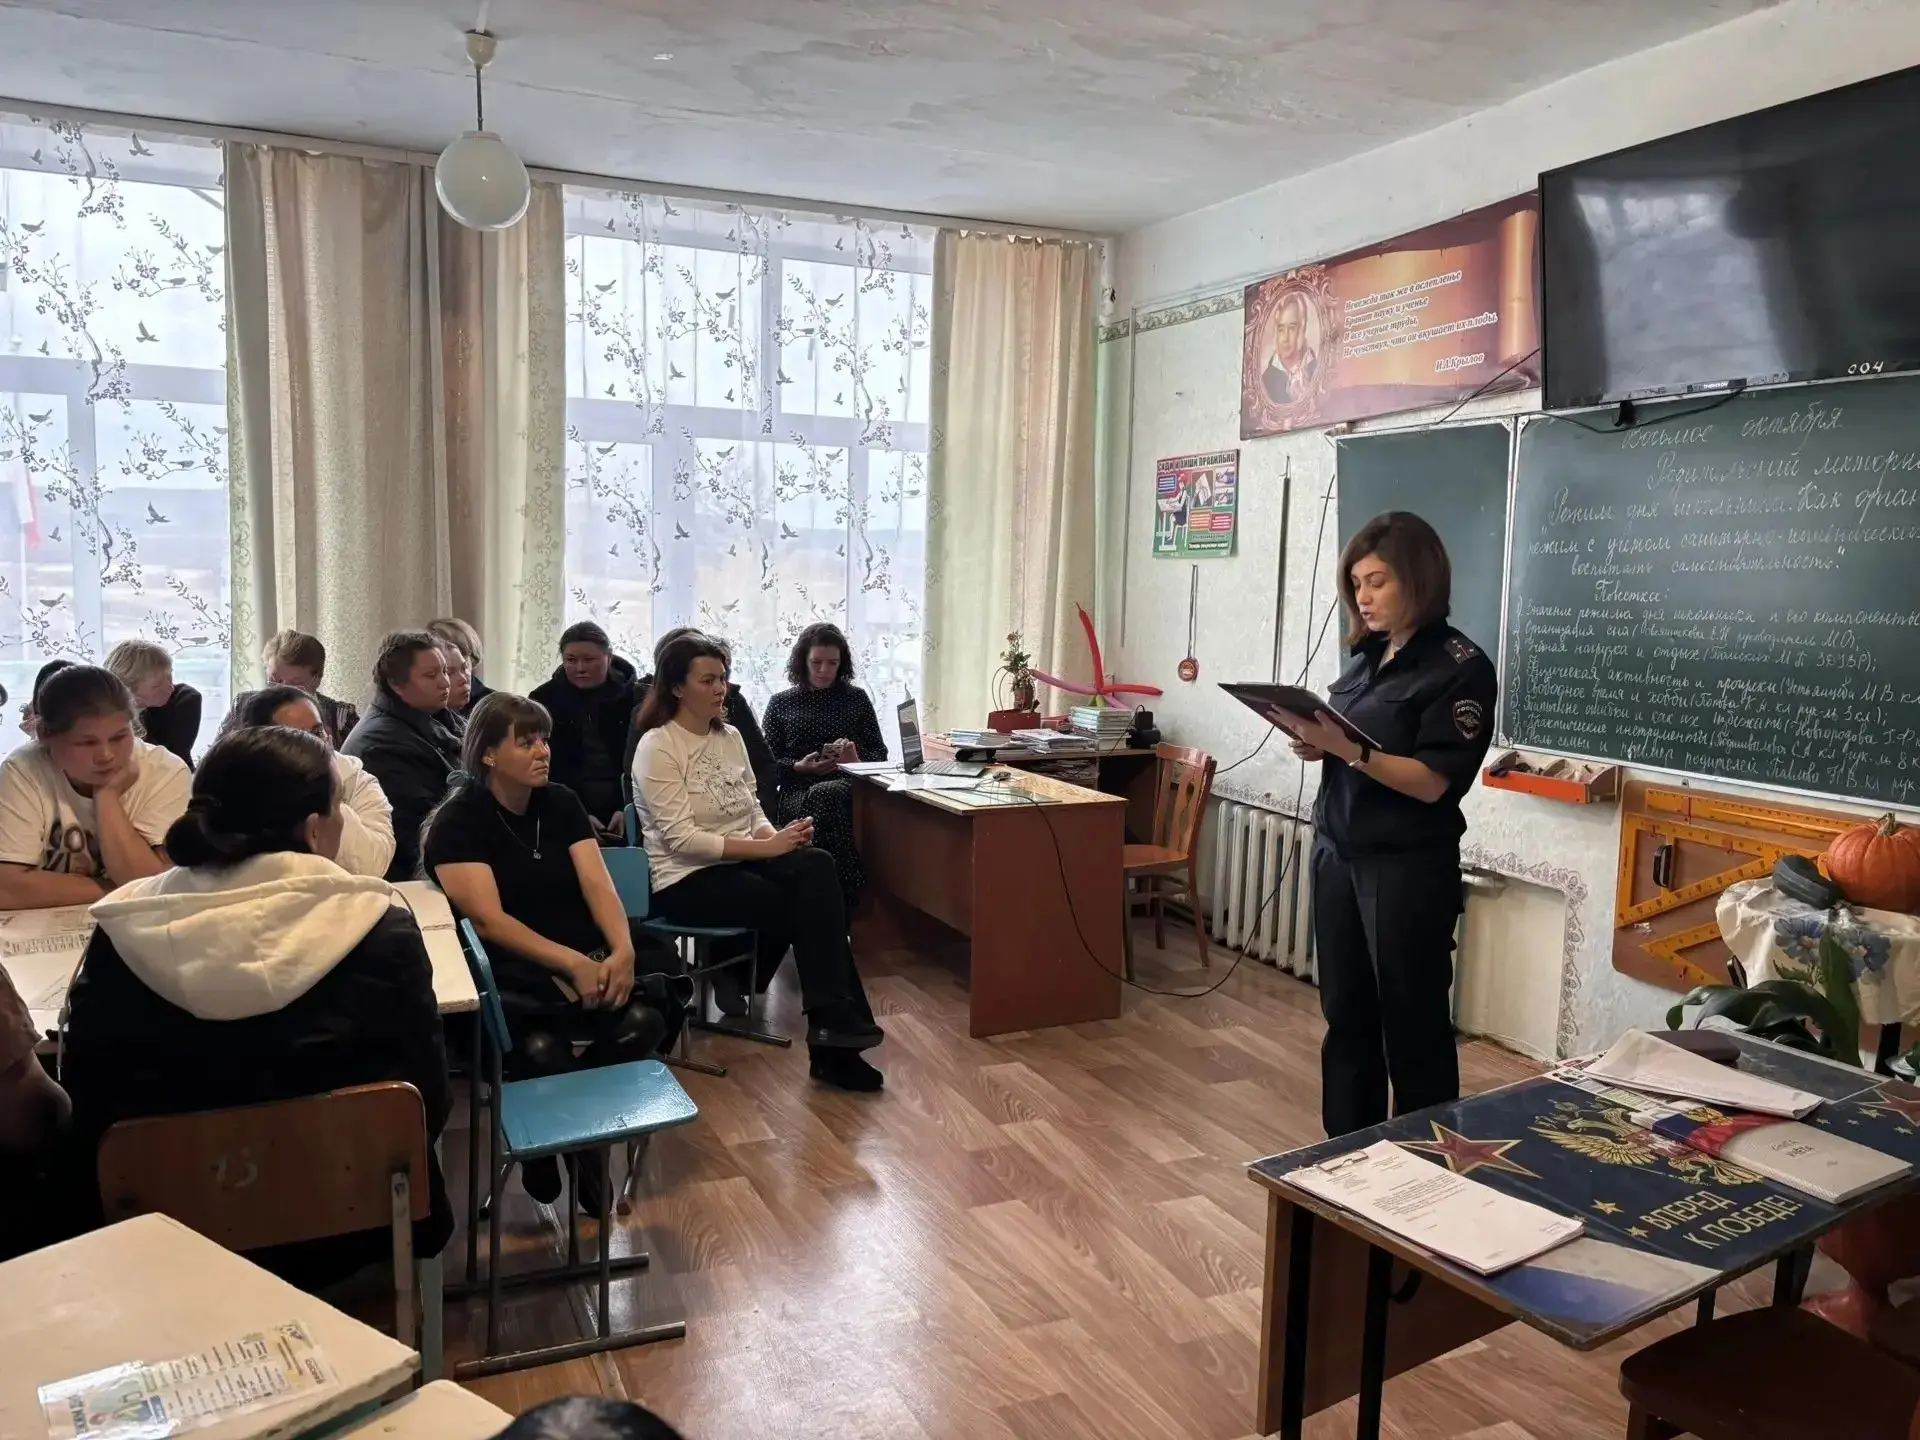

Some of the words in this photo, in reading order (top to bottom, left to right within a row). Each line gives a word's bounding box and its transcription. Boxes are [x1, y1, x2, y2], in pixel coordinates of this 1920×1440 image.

[1379, 290, 1395, 303] так
[1396, 286, 1408, 298] же
[1415, 272, 1461, 289] ослепленье
[1345, 312, 1372, 328] Бранит
[1373, 307, 1395, 320] науку
[1401, 297, 1428, 315] ученье
[1344, 345, 1353, 357] Не
[1390, 336, 1406, 347] что
[1407, 333, 1417, 343] он
[1418, 324, 1455, 342] вкушает
[1456, 321, 1466, 331] их
[1467, 312, 1498, 329] плоды.
[1350, 330, 1361, 339] все
[1741, 400, 1846, 450] октября
[1198, 453, 1235, 467] ПРАВИЛЬНО
[1797, 481, 1842, 512] Как
[1587, 538, 1596, 552] с
[1575, 607, 1633, 637] режима
[1574, 642, 1634, 667] нагрузка
[1637, 647, 1645, 658] и
[1607, 662, 1690, 686] активность
[1695, 680, 1705, 688] и
[1631, 692, 1641, 703] и
[1682, 1232, 1720, 1250] К
[1701, 1194, 1804, 1242] ПОБЕДЕ!
